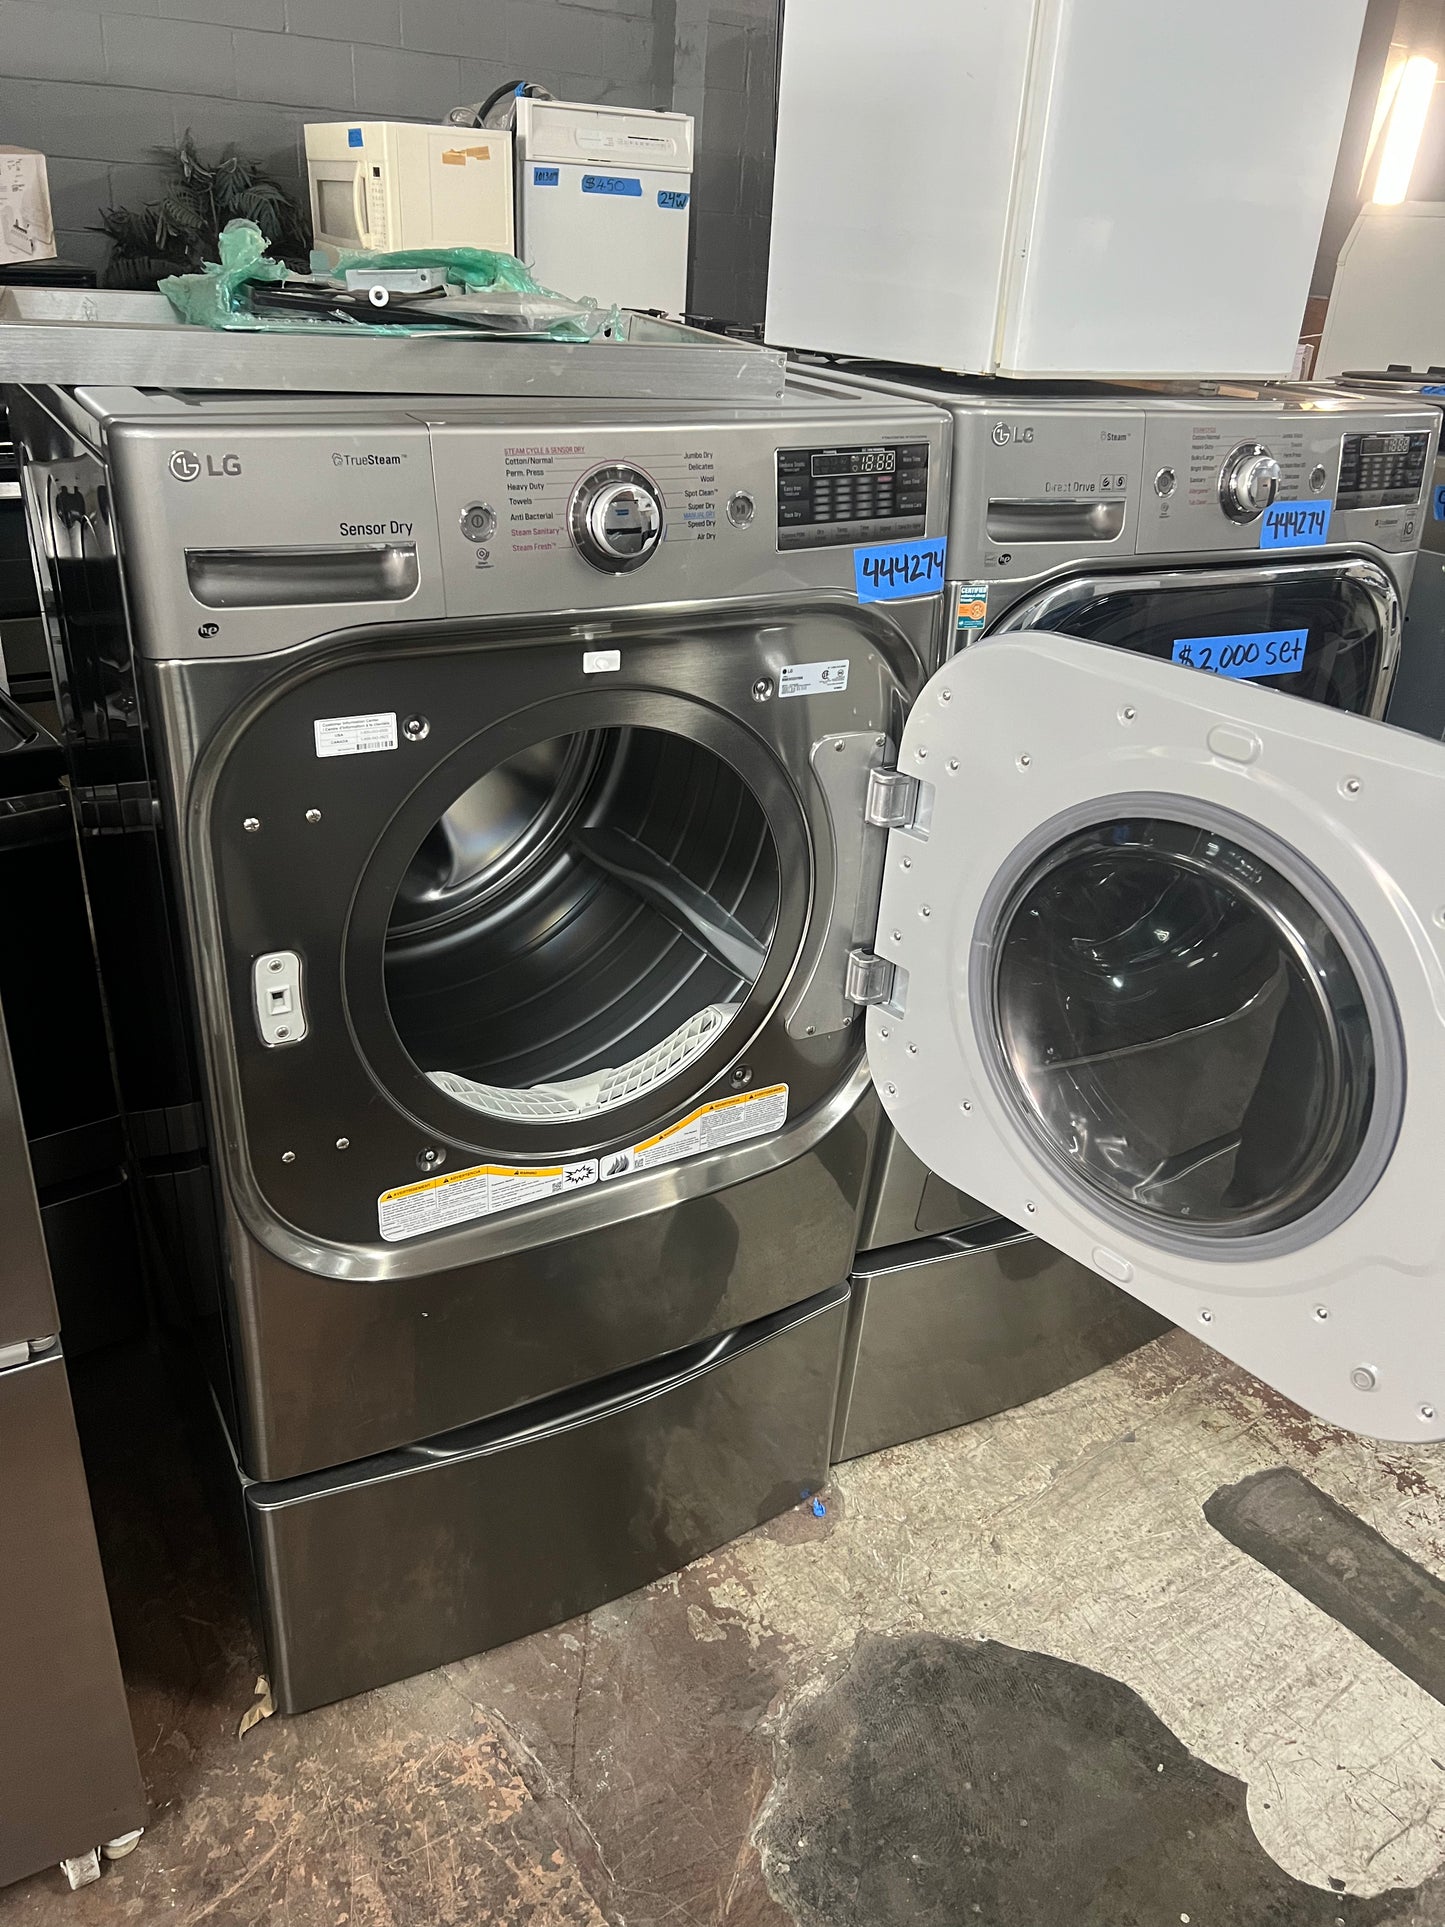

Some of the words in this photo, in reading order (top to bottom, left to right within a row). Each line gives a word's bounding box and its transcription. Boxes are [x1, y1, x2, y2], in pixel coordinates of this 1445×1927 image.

[584, 177, 625, 191] $450
[1013, 427, 1034, 443] LG
[683, 452, 702, 460] Jumbo
[703, 451, 714, 459] Dry
[207, 454, 242, 477] LG
[505, 457, 553, 466] Cotton/Normal
[861, 453, 894, 471] 18:88
[688, 463, 714, 471] Delicates
[506, 469, 524, 477] Perm.
[526, 468, 544, 476] Press
[507, 483, 528, 491] Heavy
[529, 482, 545, 490] Duty
[1073, 481, 1096, 492] Drive
[684, 490, 698, 498] Spot
[510, 513, 525, 521] Anti
[525, 512, 554, 520] Bacterial
[688, 520, 706, 528] Speed
[1267, 510, 1325, 539] 444274
[339, 522, 387, 537] Sensor
[390, 521, 413, 536] Dry
[512, 544, 533, 552] Steam
[863, 549, 944, 587] 444274
